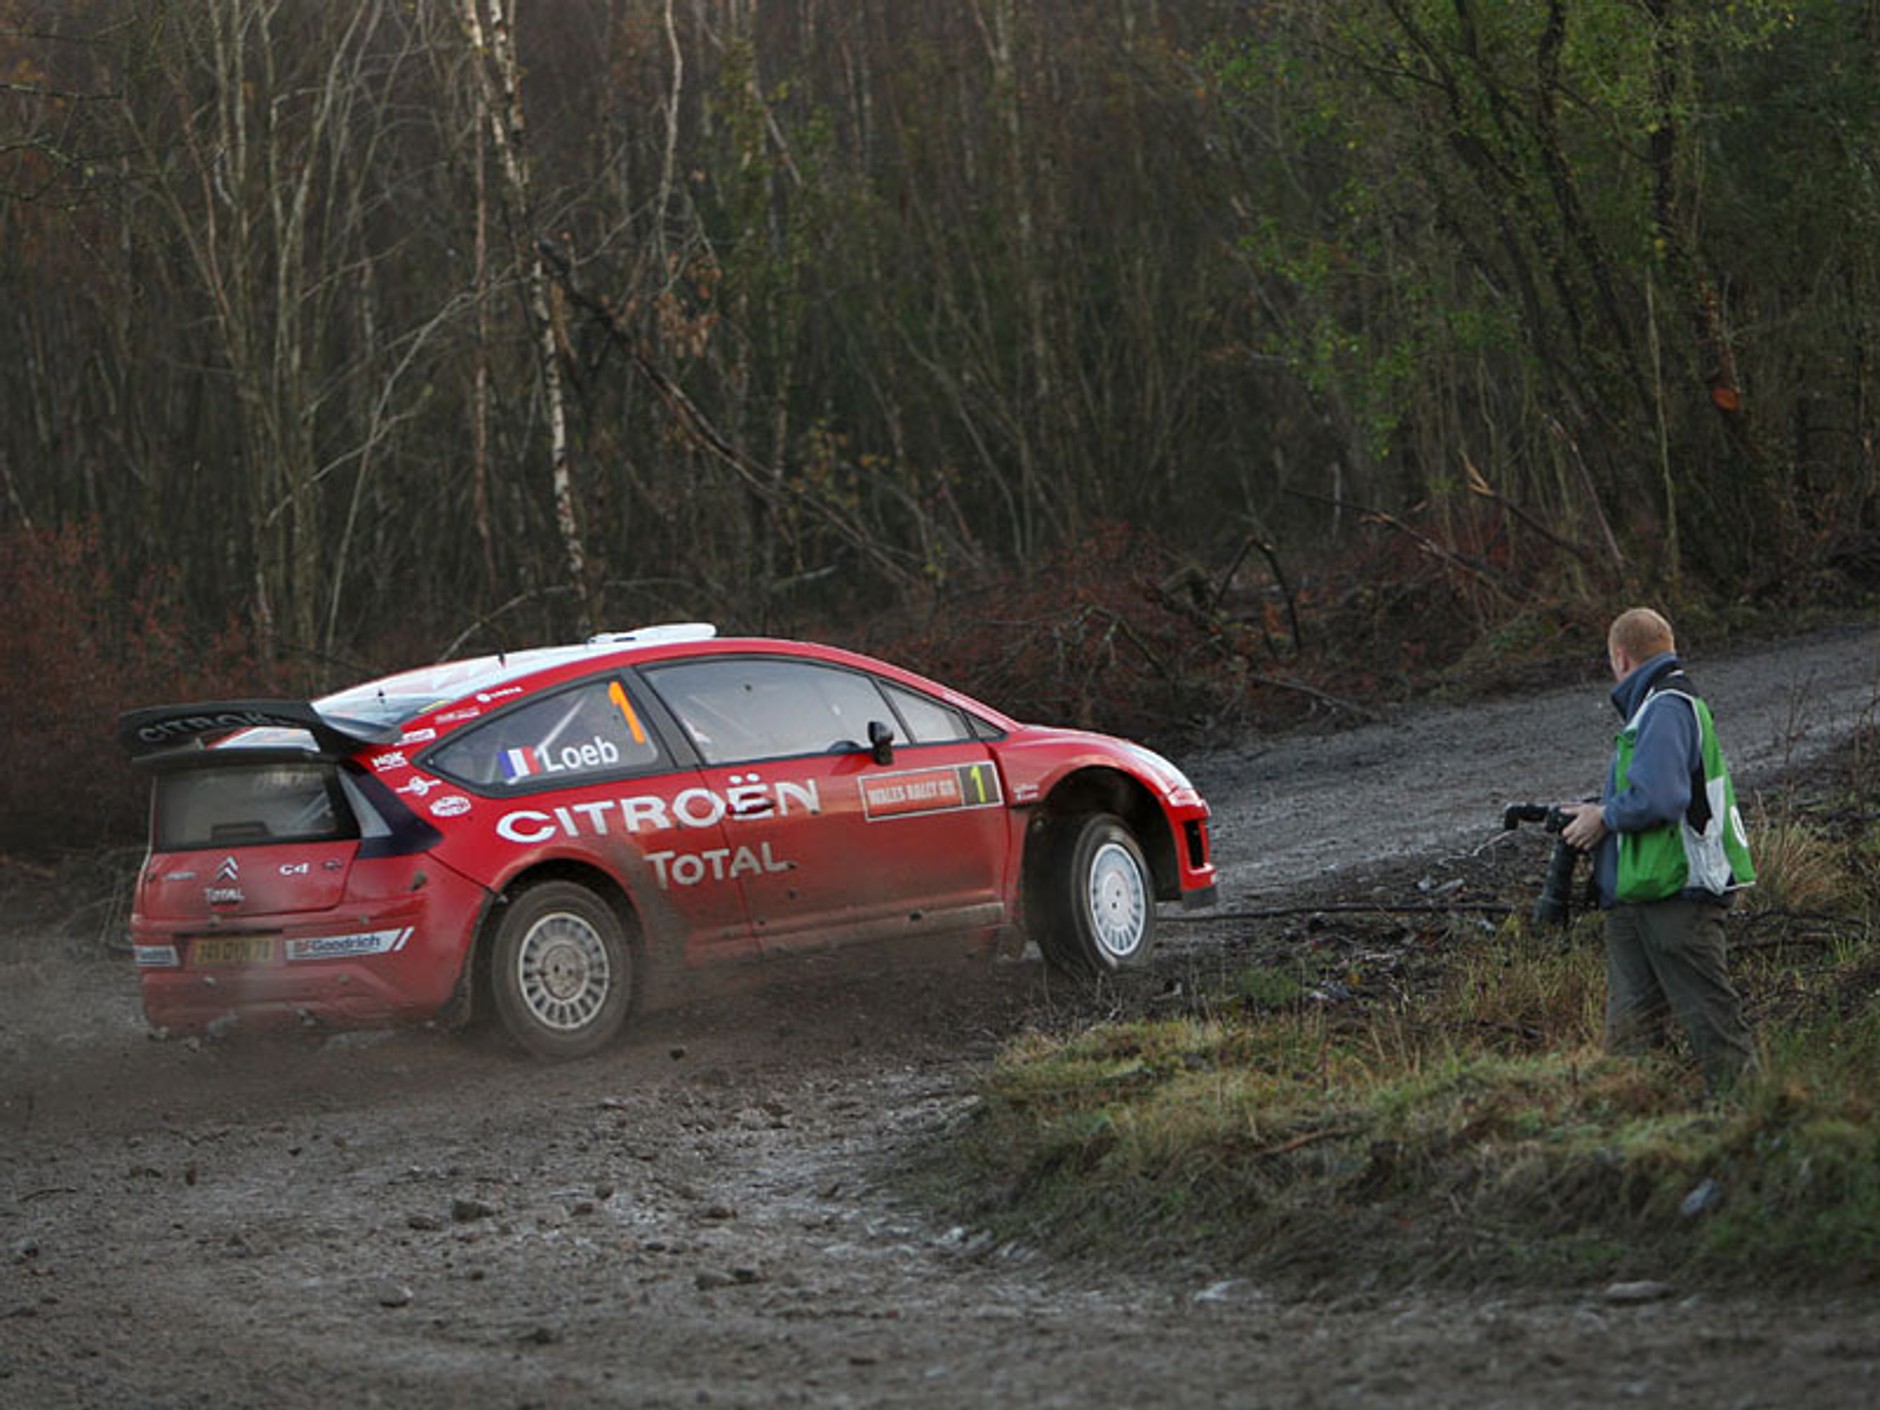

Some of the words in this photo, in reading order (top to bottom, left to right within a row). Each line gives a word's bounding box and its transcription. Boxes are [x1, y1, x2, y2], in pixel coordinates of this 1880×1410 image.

[609, 681, 645, 744] 1
[542, 735, 619, 772] Loeb
[868, 786, 906, 805] WALES
[907, 780, 937, 801] RALLY
[970, 764, 986, 803] 1
[496, 773, 821, 843] CITROËN
[279, 862, 309, 876] C4
